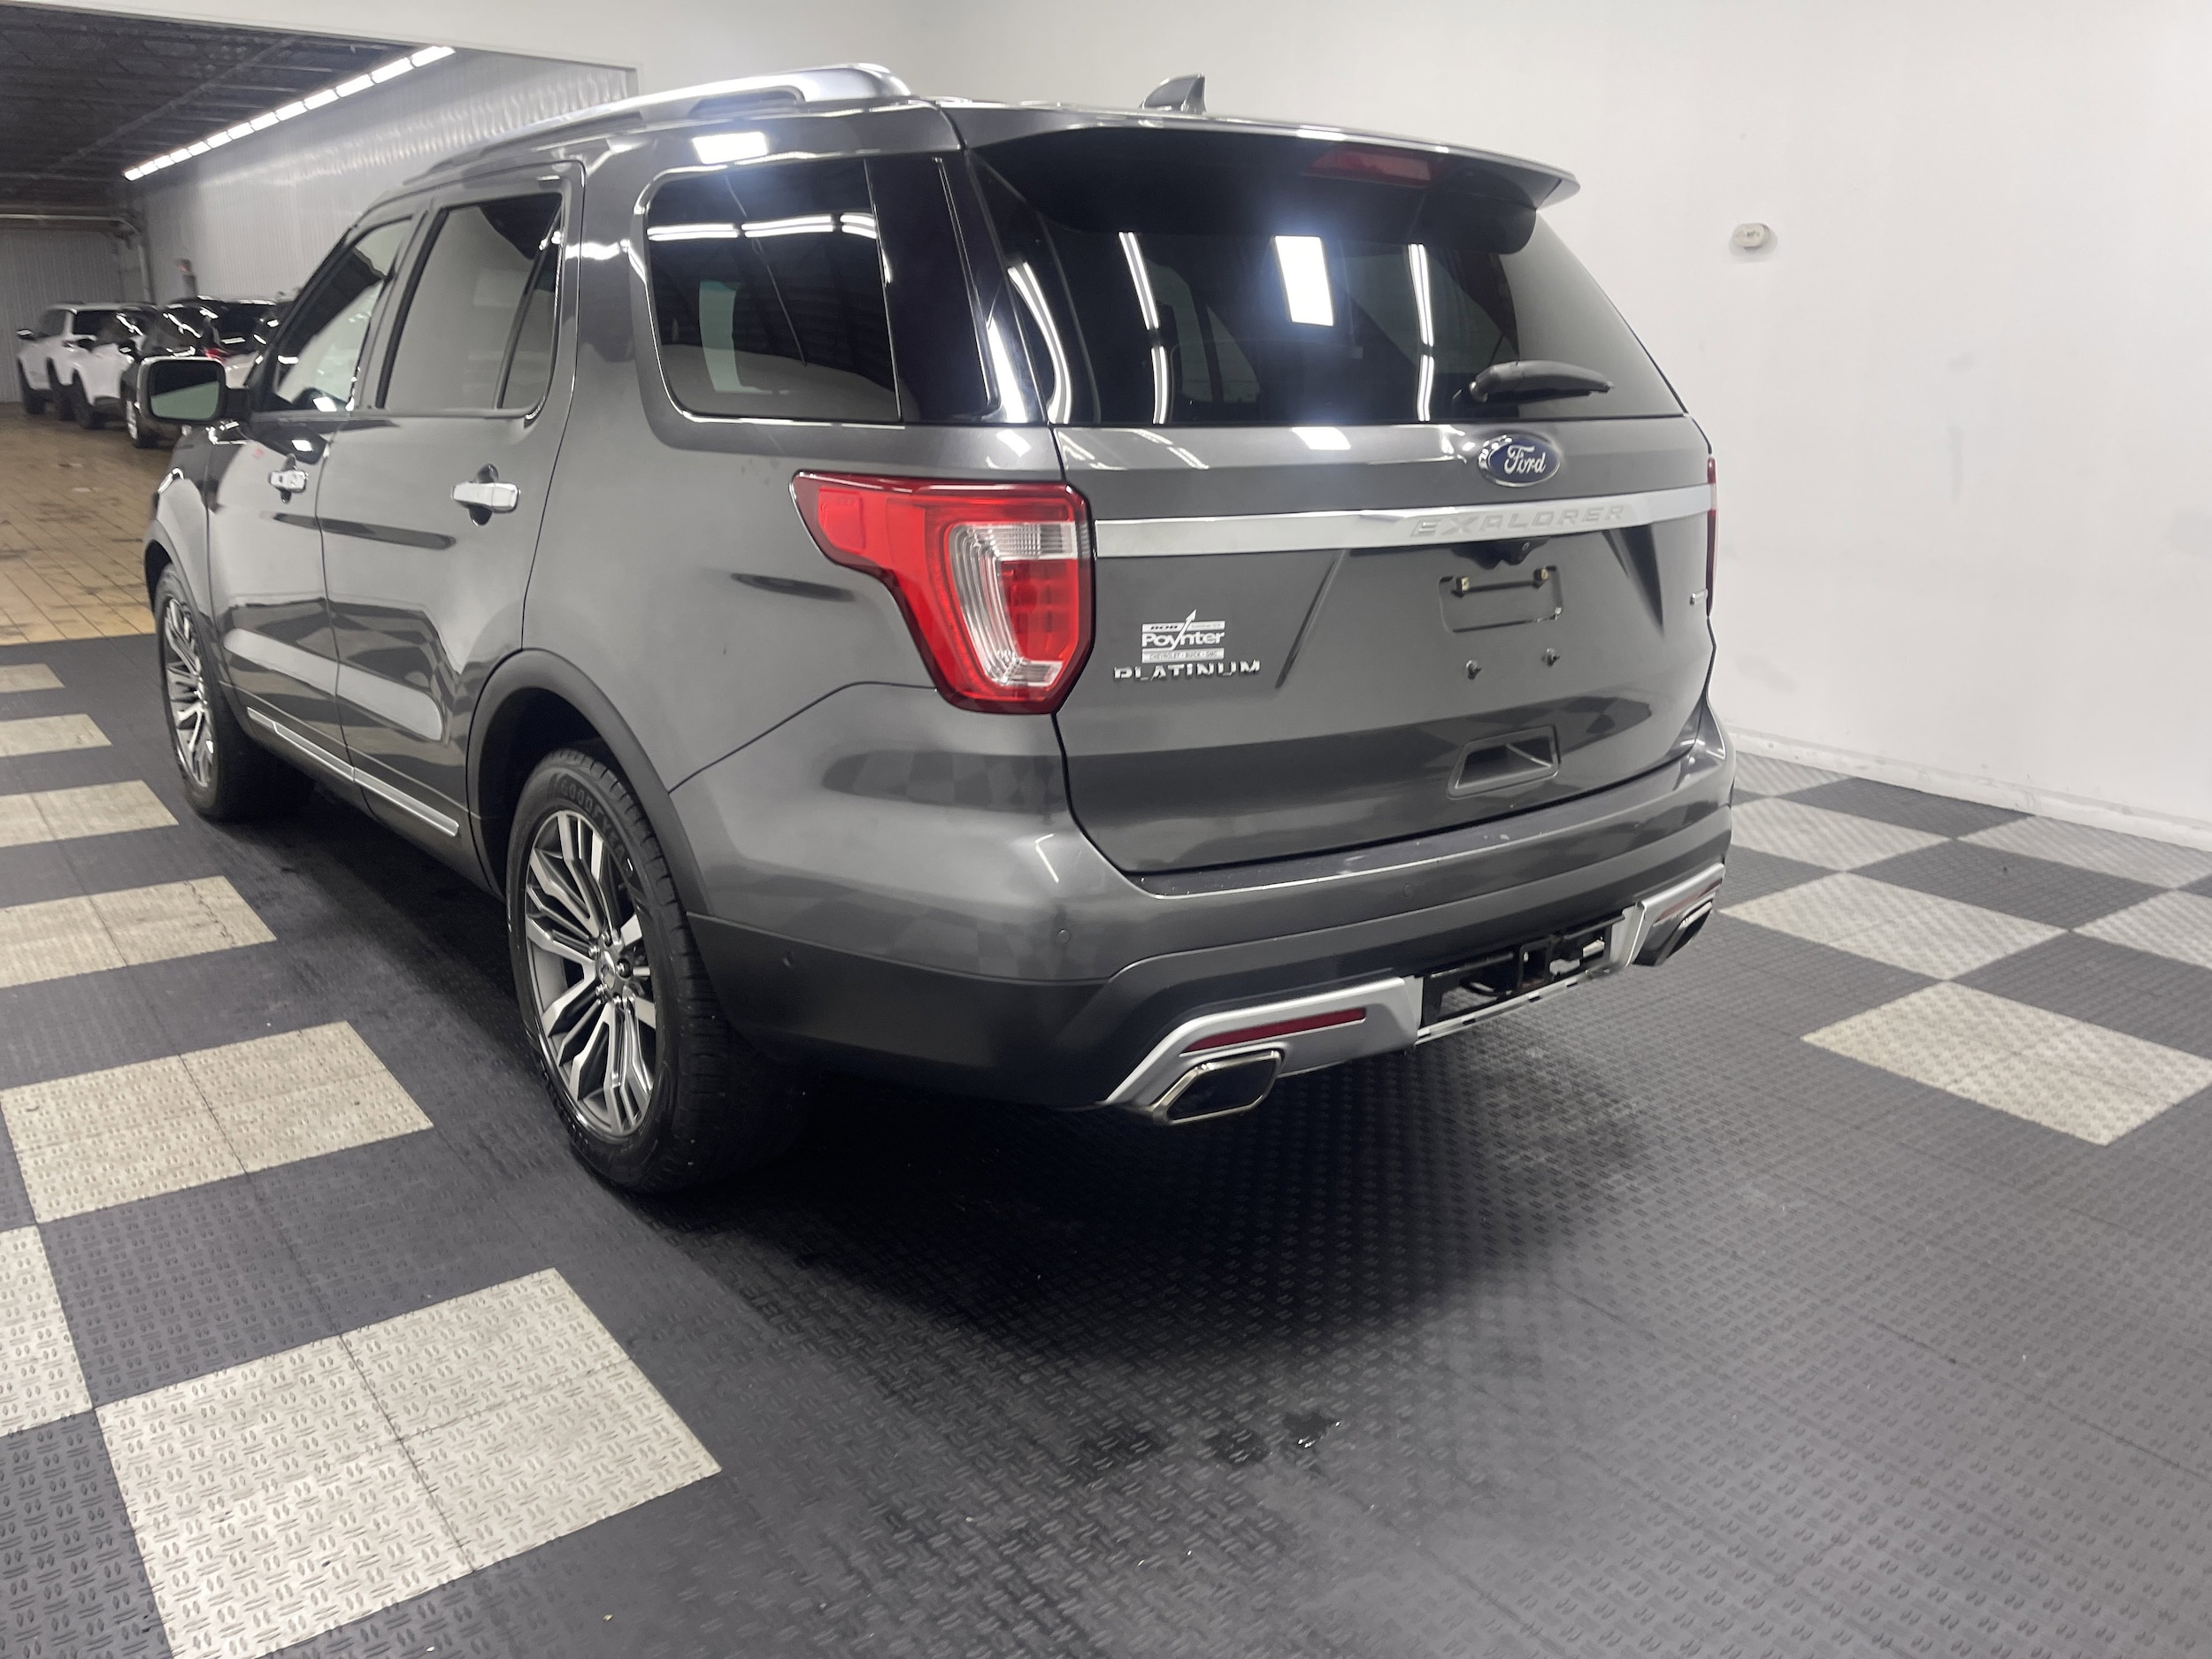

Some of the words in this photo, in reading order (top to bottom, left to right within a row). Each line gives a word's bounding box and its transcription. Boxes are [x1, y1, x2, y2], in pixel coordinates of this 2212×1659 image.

[1503, 444, 1547, 475] Ford
[1409, 505, 1624, 538] EXPLORER
[1141, 631, 1225, 650] Poynter
[1114, 660, 1261, 680] PLATINUM
